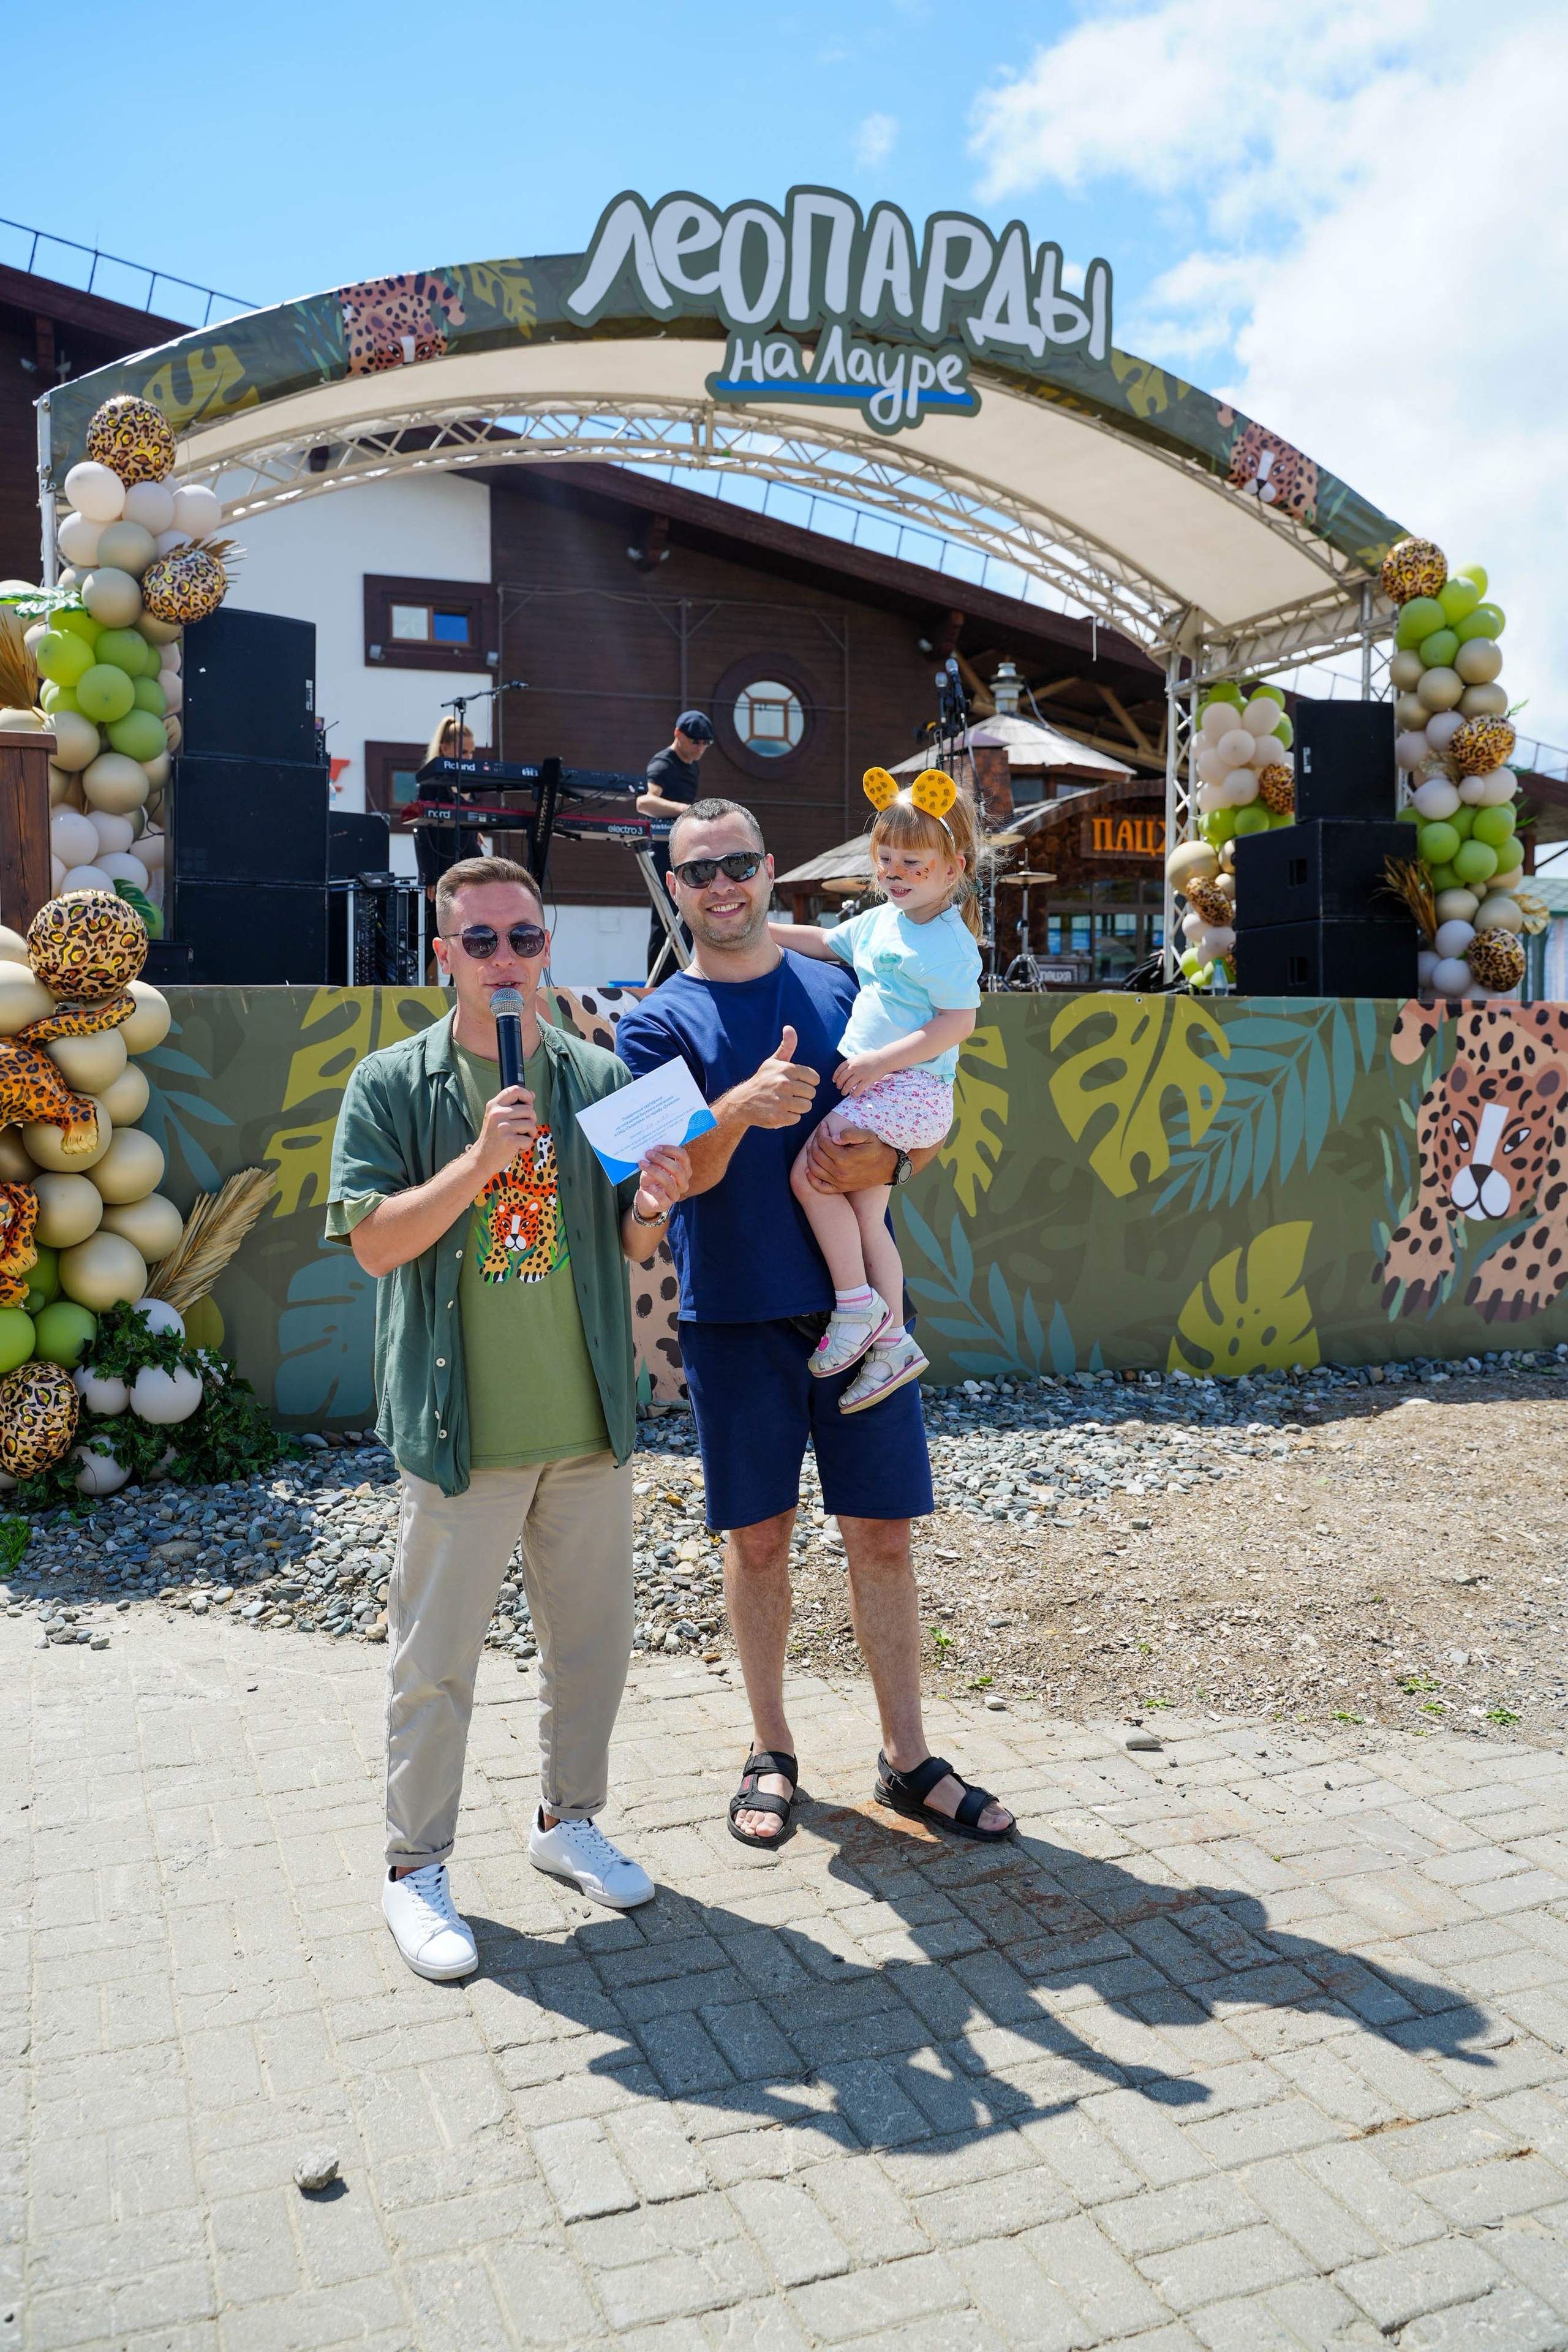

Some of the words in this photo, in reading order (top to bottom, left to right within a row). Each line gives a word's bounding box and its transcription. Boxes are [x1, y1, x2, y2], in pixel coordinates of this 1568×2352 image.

[728, 336, 799, 383] на
[815, 323, 967, 426] Лауре
[607, 824, 637, 834] electro
[1091, 817, 1166, 857] ПАЦ
